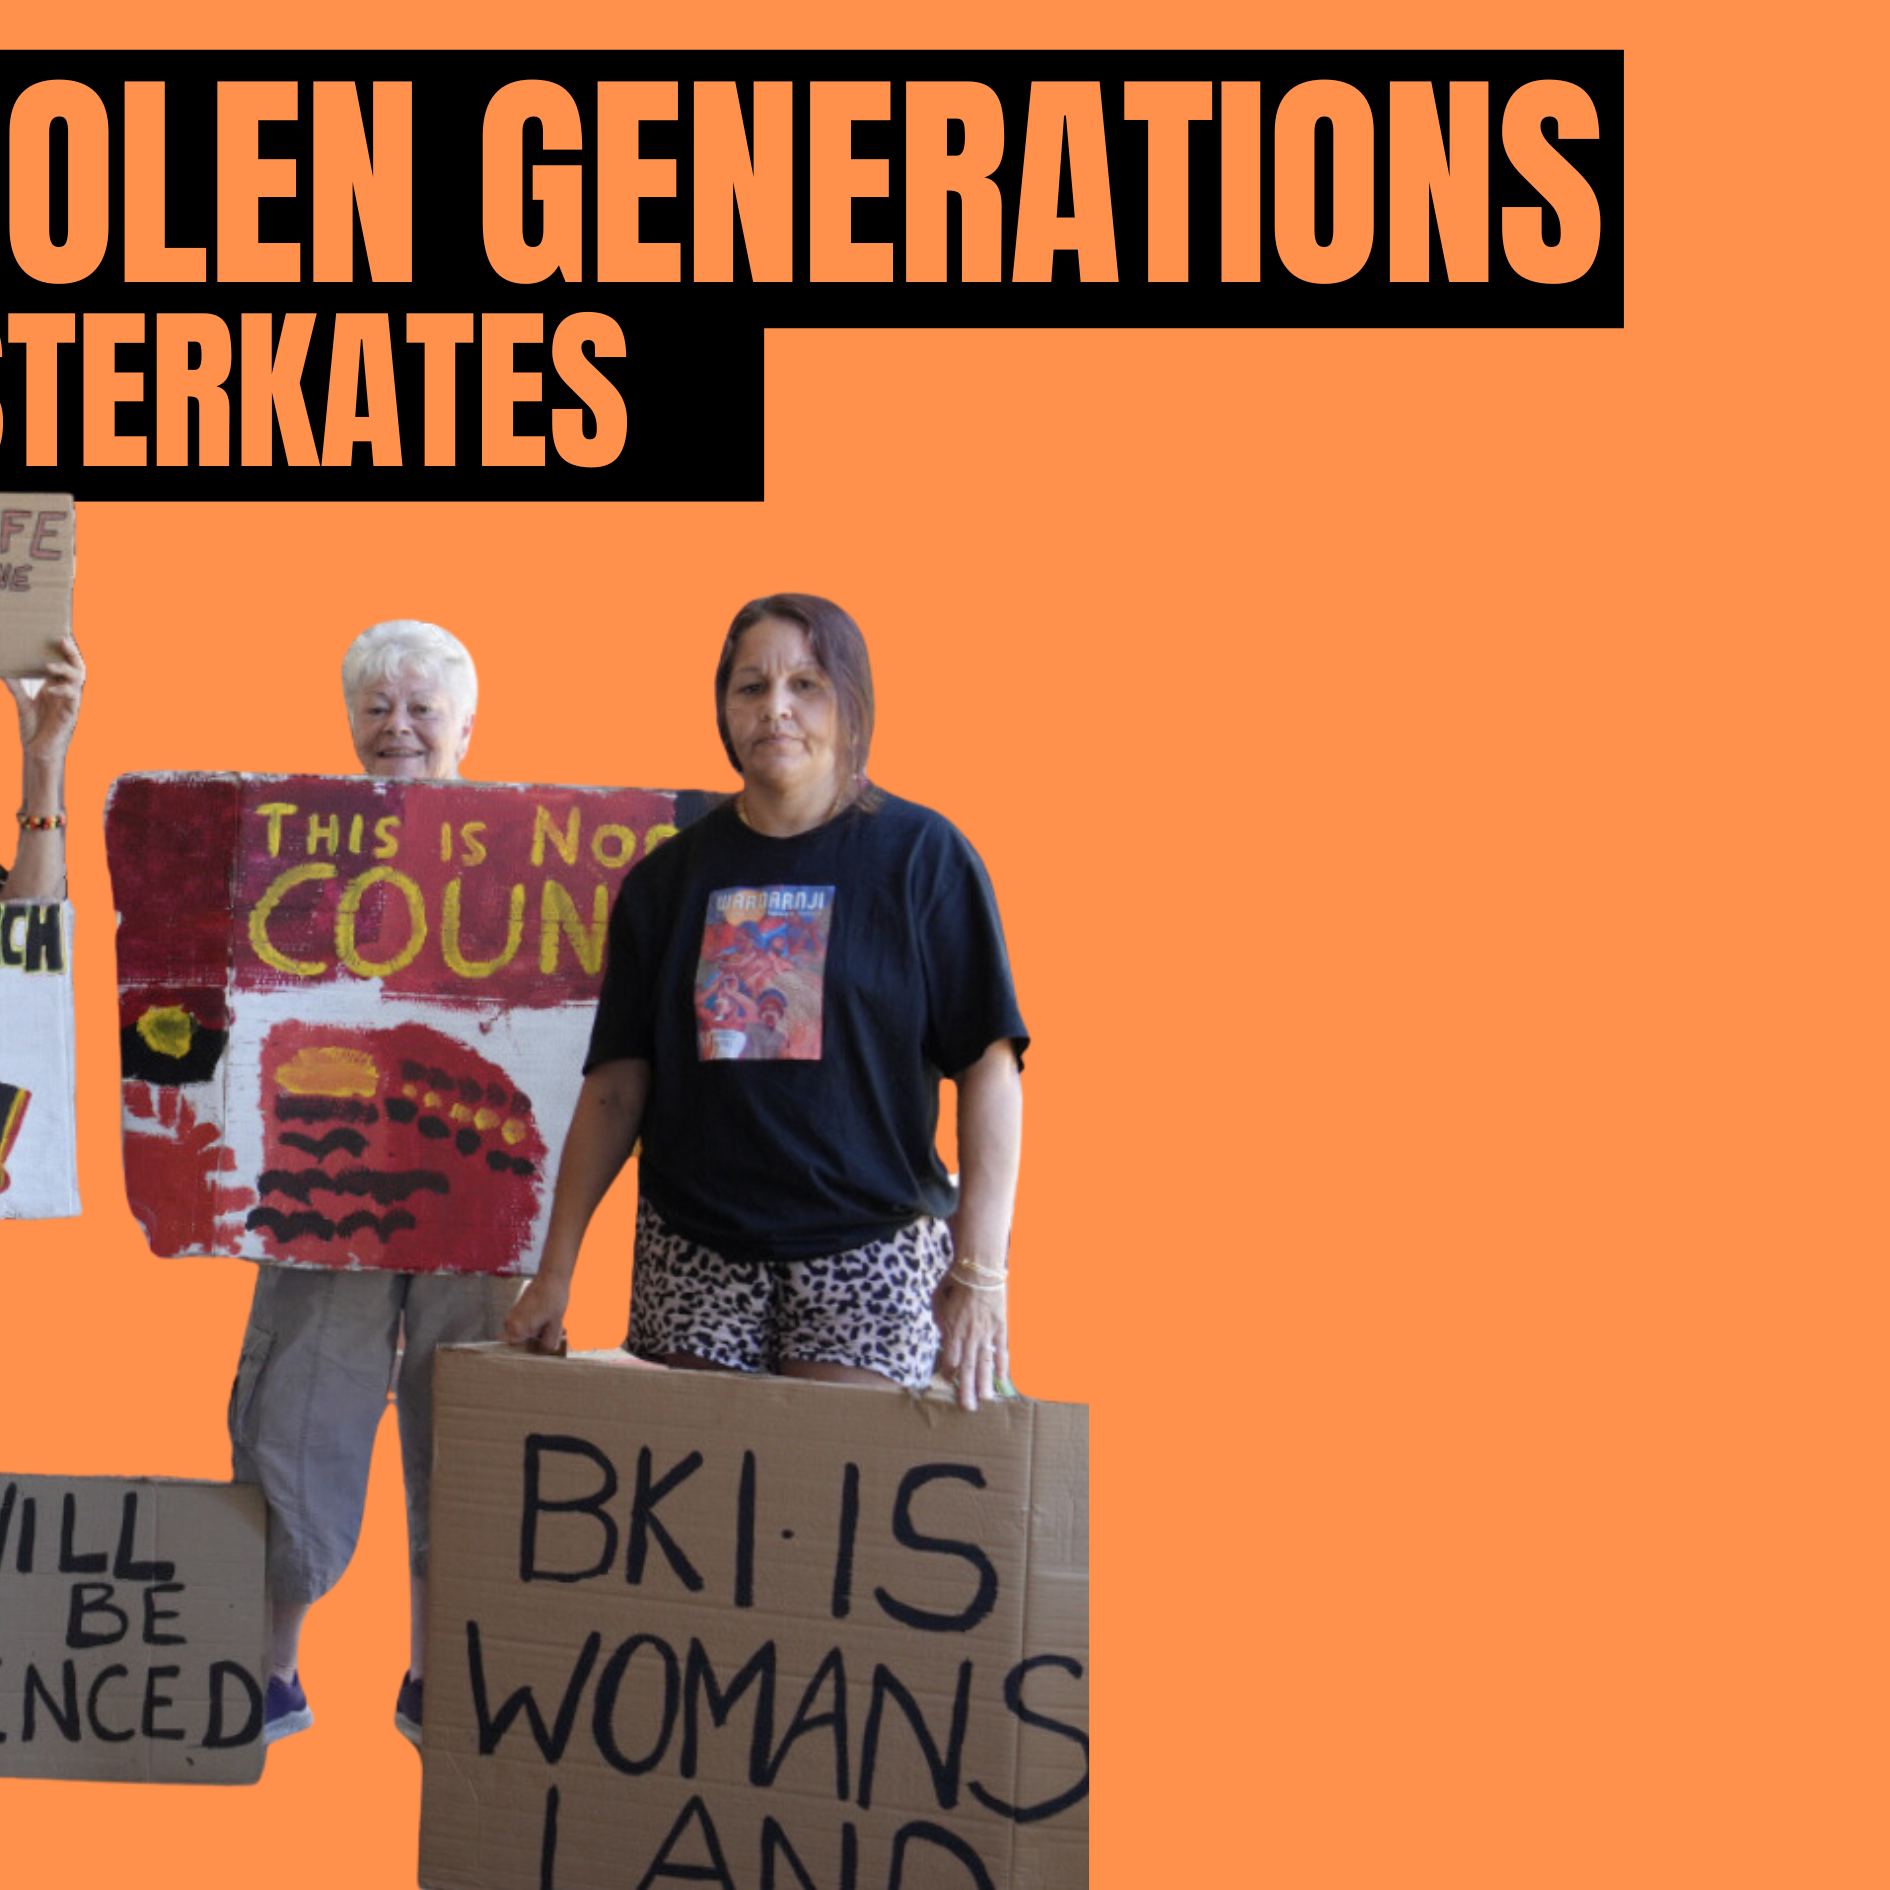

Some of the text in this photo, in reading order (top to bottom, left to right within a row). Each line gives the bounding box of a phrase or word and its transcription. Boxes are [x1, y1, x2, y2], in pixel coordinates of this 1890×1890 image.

[256, 802, 401, 859] THIS
[440, 821, 487, 867] IS
[66, 1582, 187, 1647] BE
[467, 1620, 1089, 1823] WOMANS
